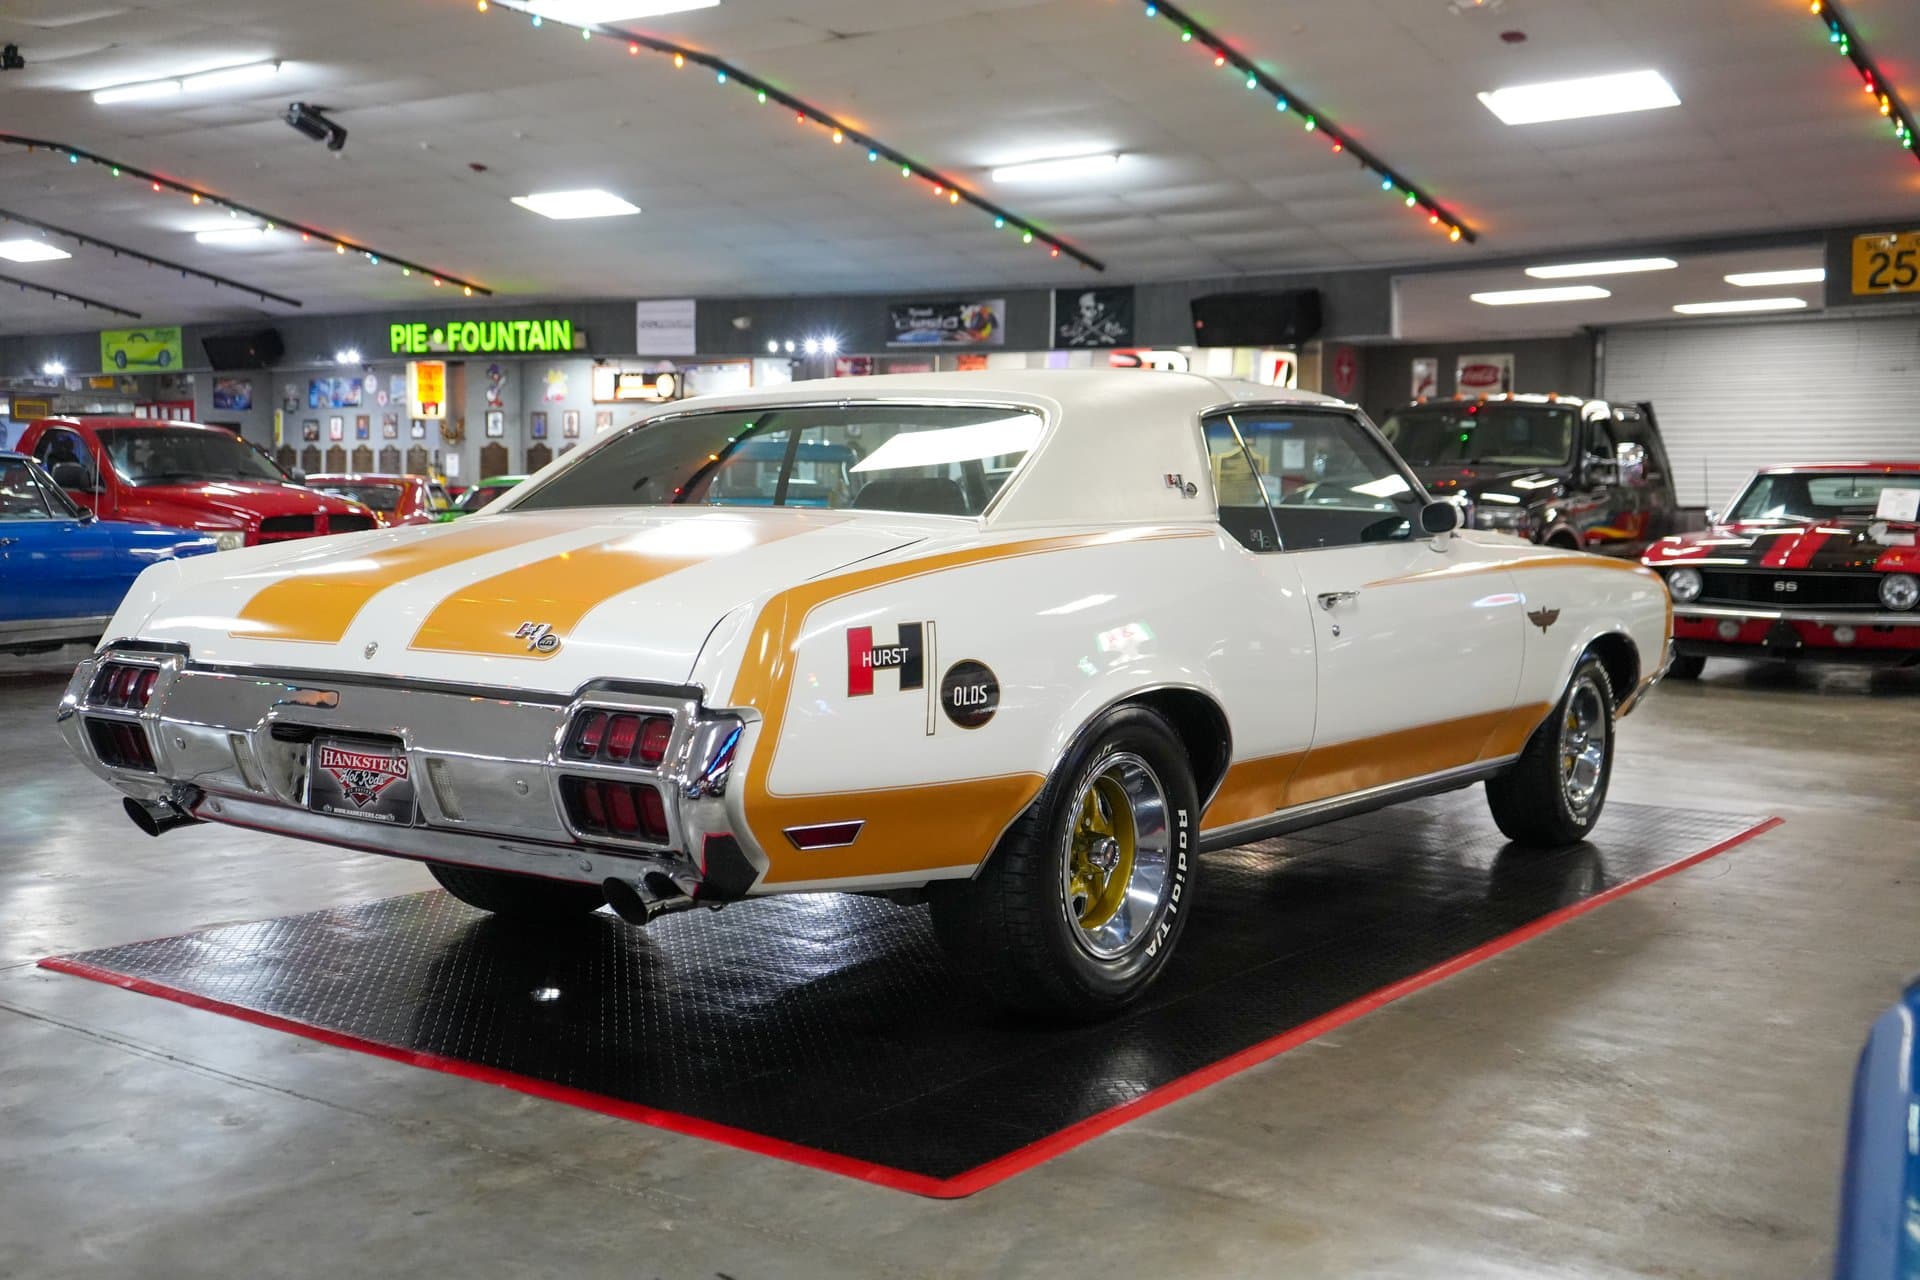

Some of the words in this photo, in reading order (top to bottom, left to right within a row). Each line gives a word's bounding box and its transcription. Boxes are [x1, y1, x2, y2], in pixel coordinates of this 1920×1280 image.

[1869, 250, 1919, 288] 25
[390, 324, 427, 352] PIE
[447, 320, 572, 352] FOUNTAIN
[1773, 580, 1799, 593] SS
[862, 647, 909, 668] HURST
[953, 684, 988, 707] OLDS
[322, 749, 407, 776] HANKSTERS
[340, 768, 359, 784] Hot
[358, 770, 385, 789] Rods
[1168, 809, 1189, 914] Radial
[1145, 922, 1172, 958] T/A
